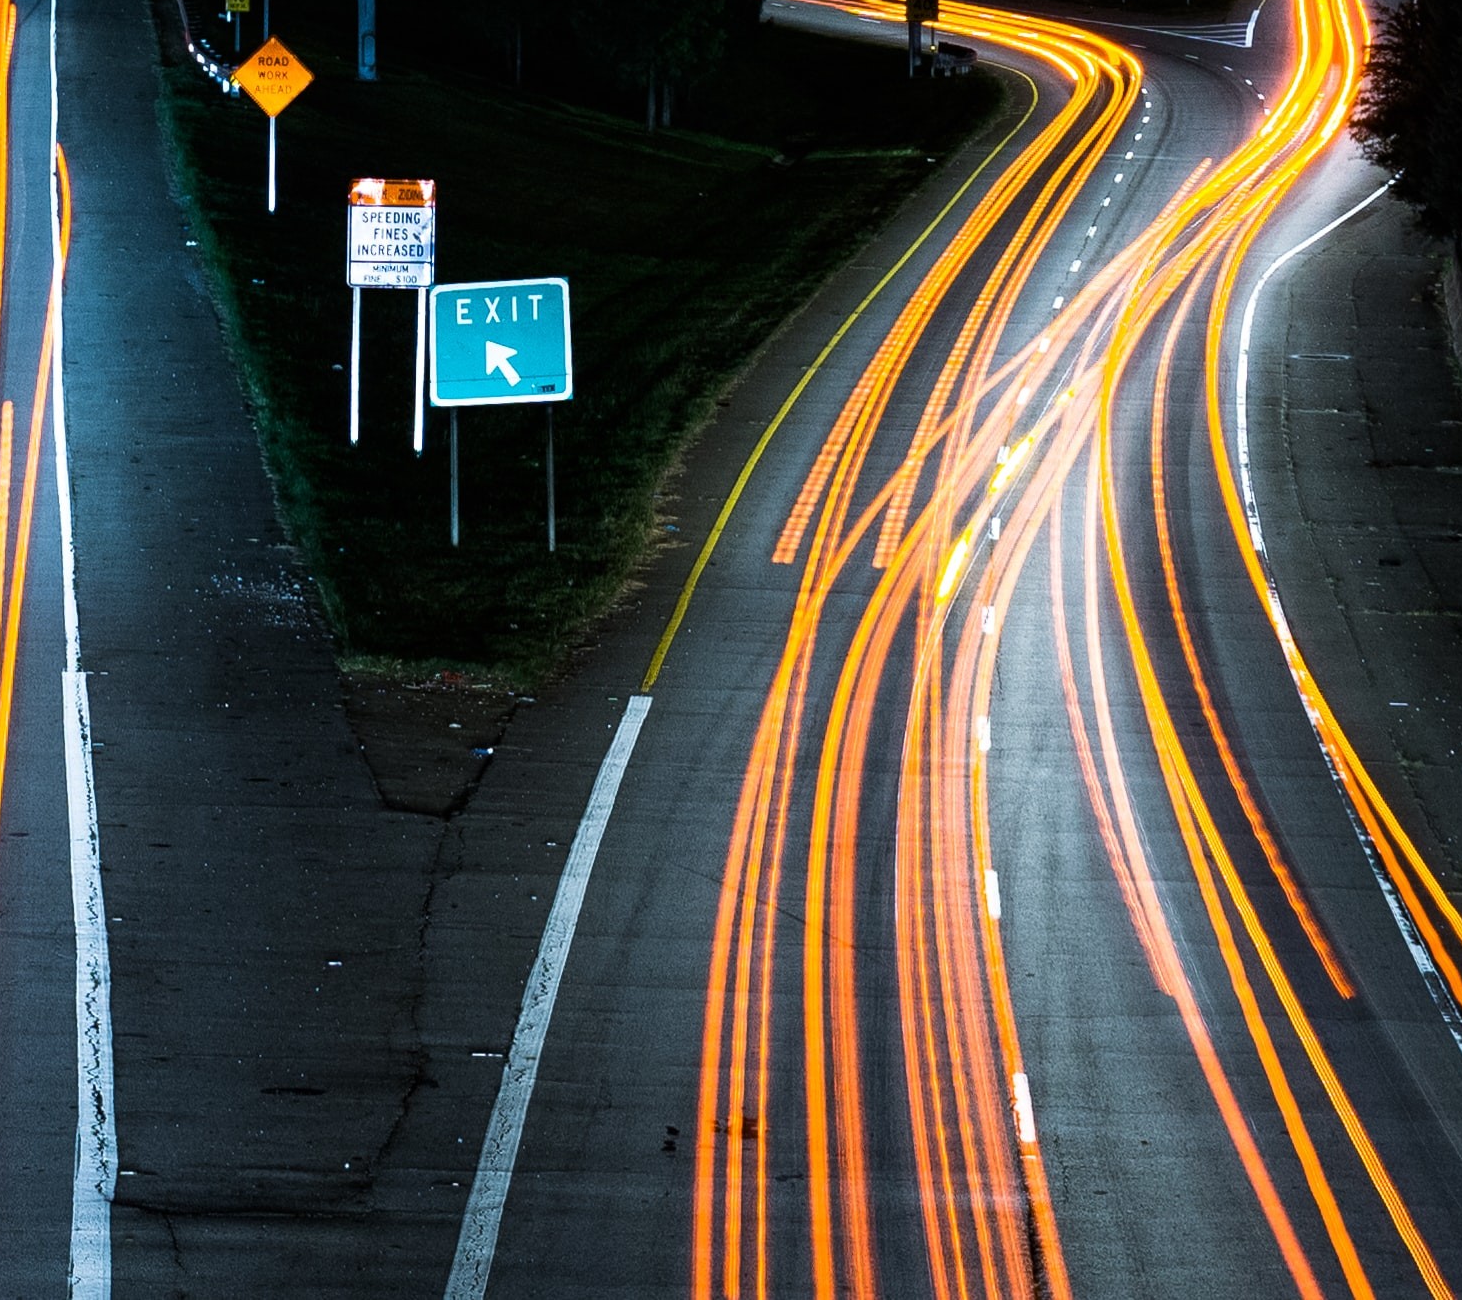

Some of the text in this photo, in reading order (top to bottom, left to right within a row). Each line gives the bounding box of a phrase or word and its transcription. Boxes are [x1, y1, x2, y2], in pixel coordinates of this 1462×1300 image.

[258, 56, 290, 67] ROAD
[258, 71, 289, 80] WORK
[255, 85, 292, 94] AHEAD
[362, 211, 421, 224] SPEEDING
[373, 228, 409, 240] FINES
[357, 244, 424, 257] INCREASED
[372, 265, 409, 273] MINIMUM
[363, 275, 417, 284] FINE $100
[456, 294, 543, 325] EXIT
